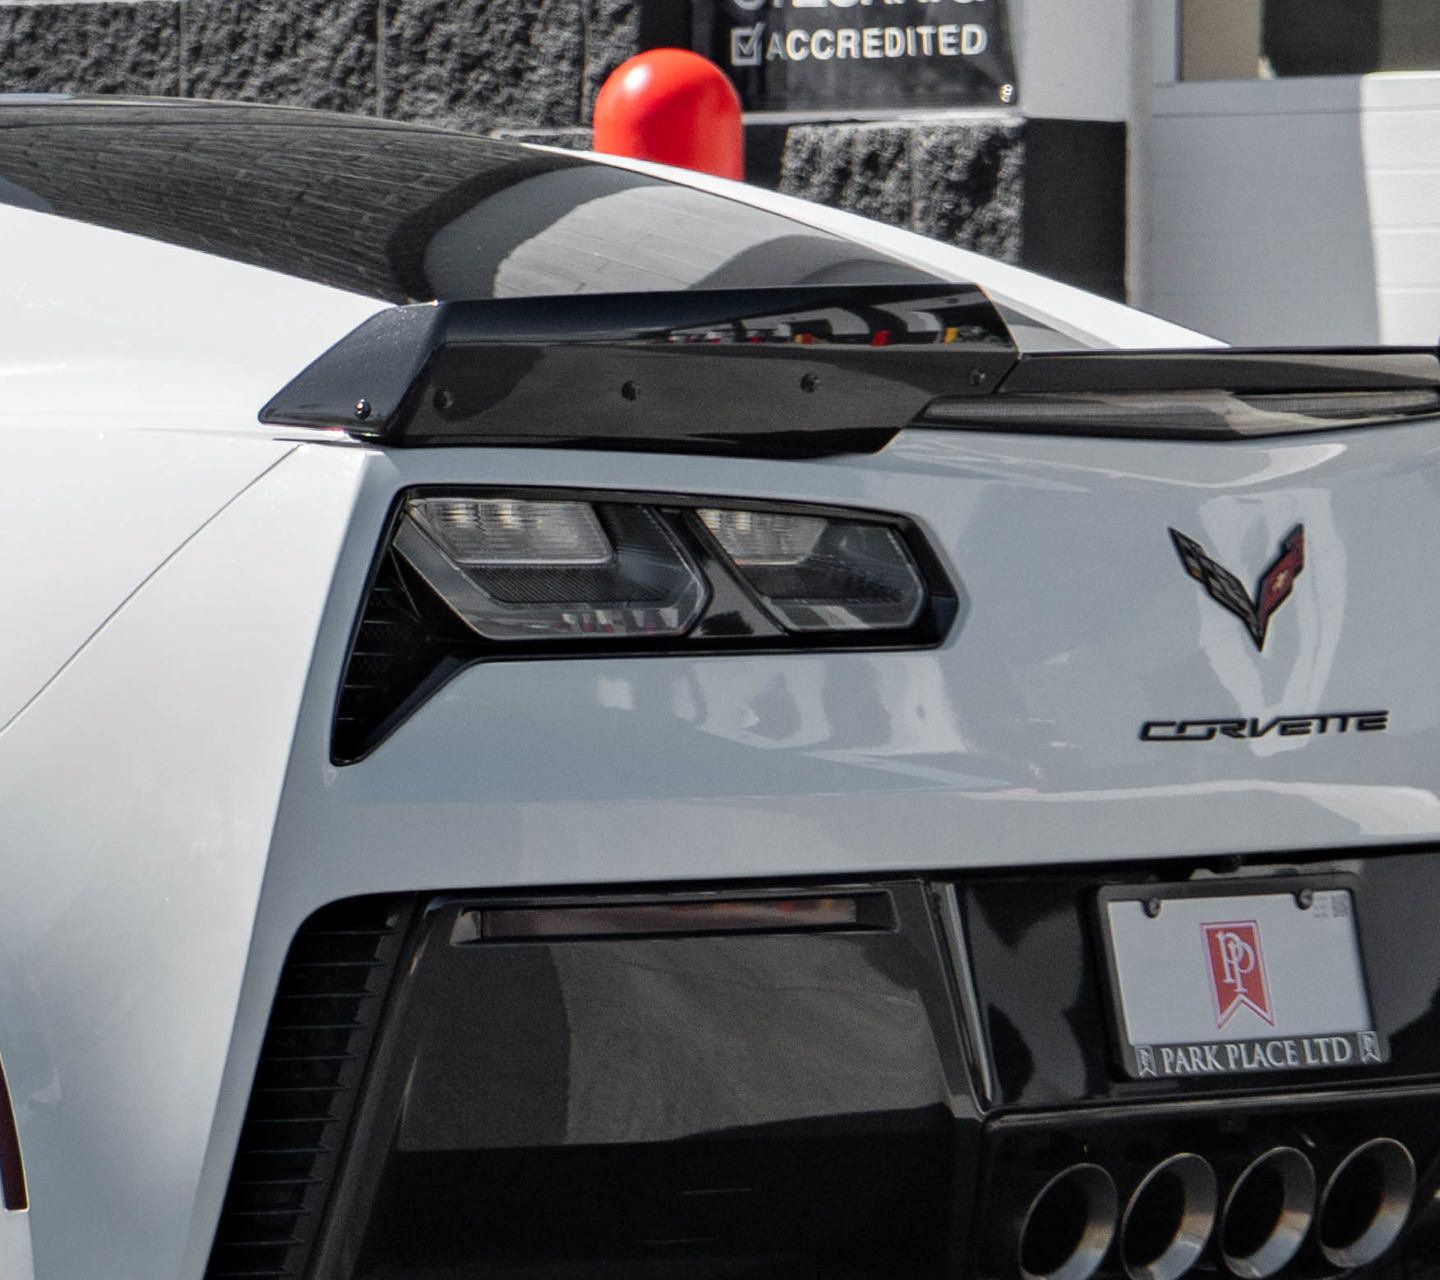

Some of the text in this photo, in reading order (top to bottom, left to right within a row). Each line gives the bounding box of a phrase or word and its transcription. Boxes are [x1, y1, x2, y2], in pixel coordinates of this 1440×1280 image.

[767, 24, 988, 61] ACCREDITED
[1139, 710, 1388, 742] CORVETTE
[1161, 1045, 1224, 1075] PARK
[1225, 1040, 1298, 1070] PLACE
[1303, 1036, 1353, 1065] LTD
